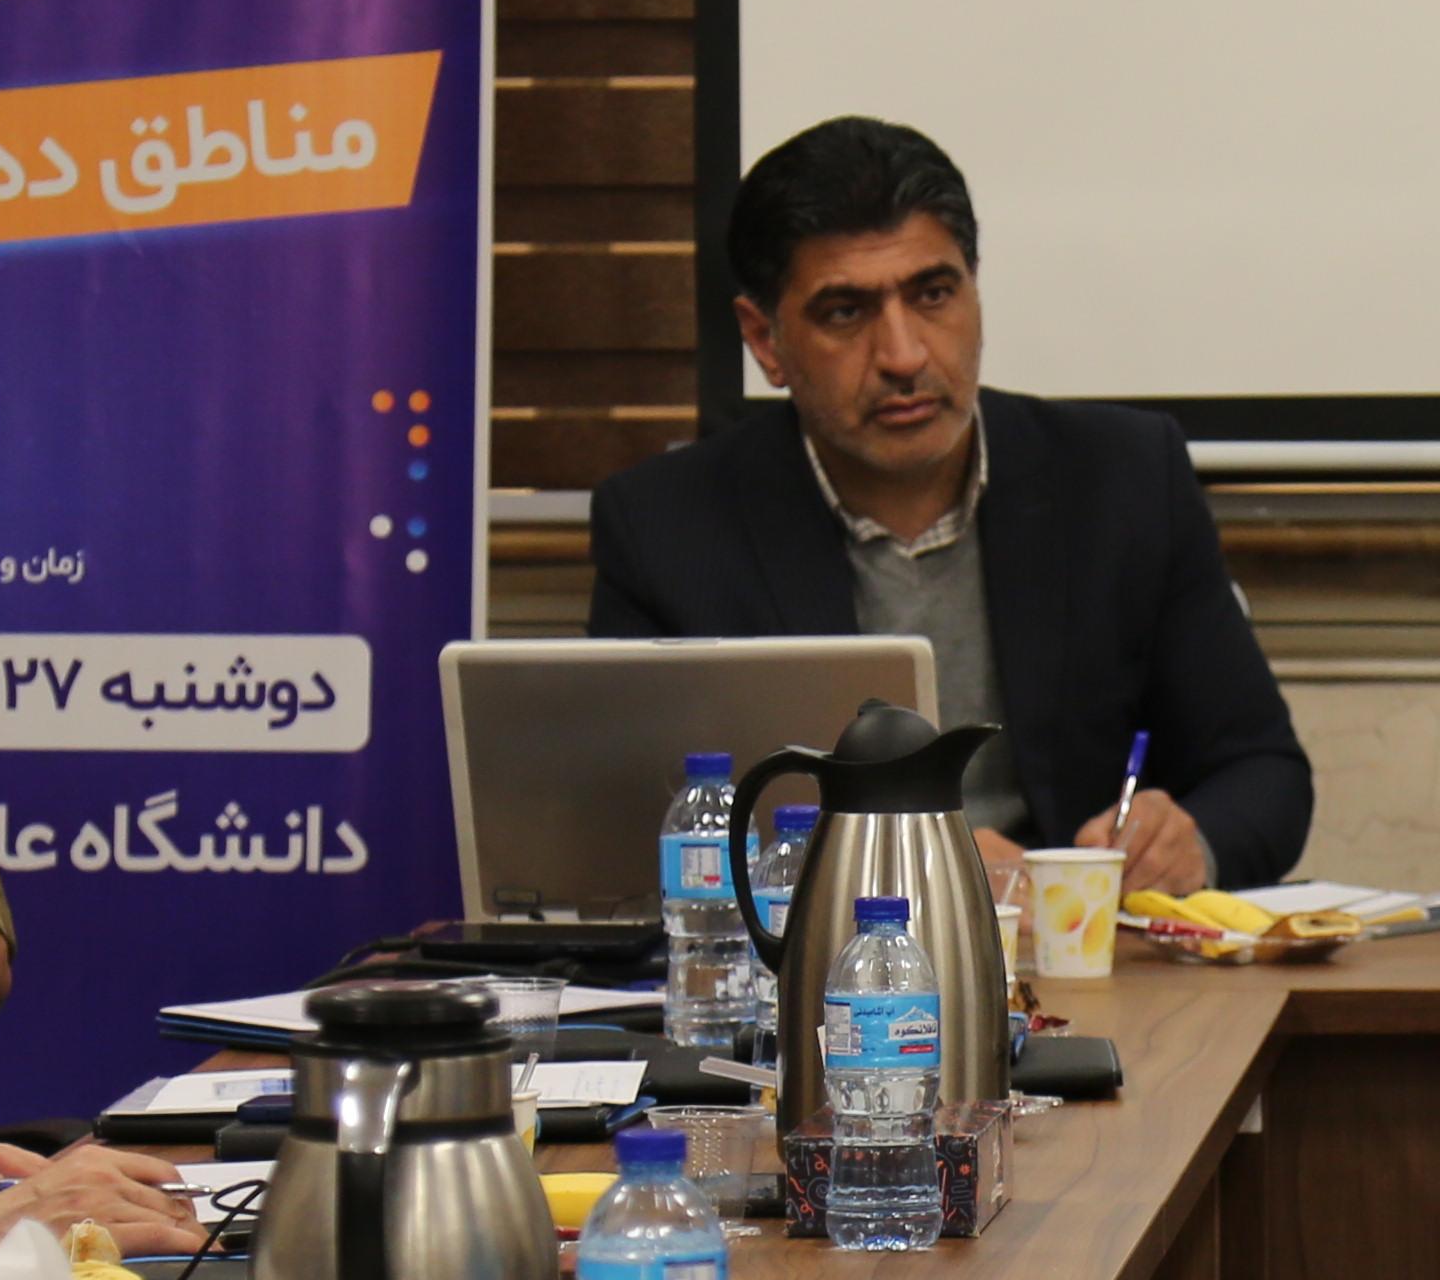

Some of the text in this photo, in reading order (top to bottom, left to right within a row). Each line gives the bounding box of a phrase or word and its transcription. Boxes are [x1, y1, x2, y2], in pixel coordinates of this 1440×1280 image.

[99, 99, 378, 215] مناطق
[21, 547, 85, 584] زمان
[2, 657, 83, 710] ۲۷
[100, 656, 336, 730] دوشنبه
[70, 791, 367, 872] دانشگاه
